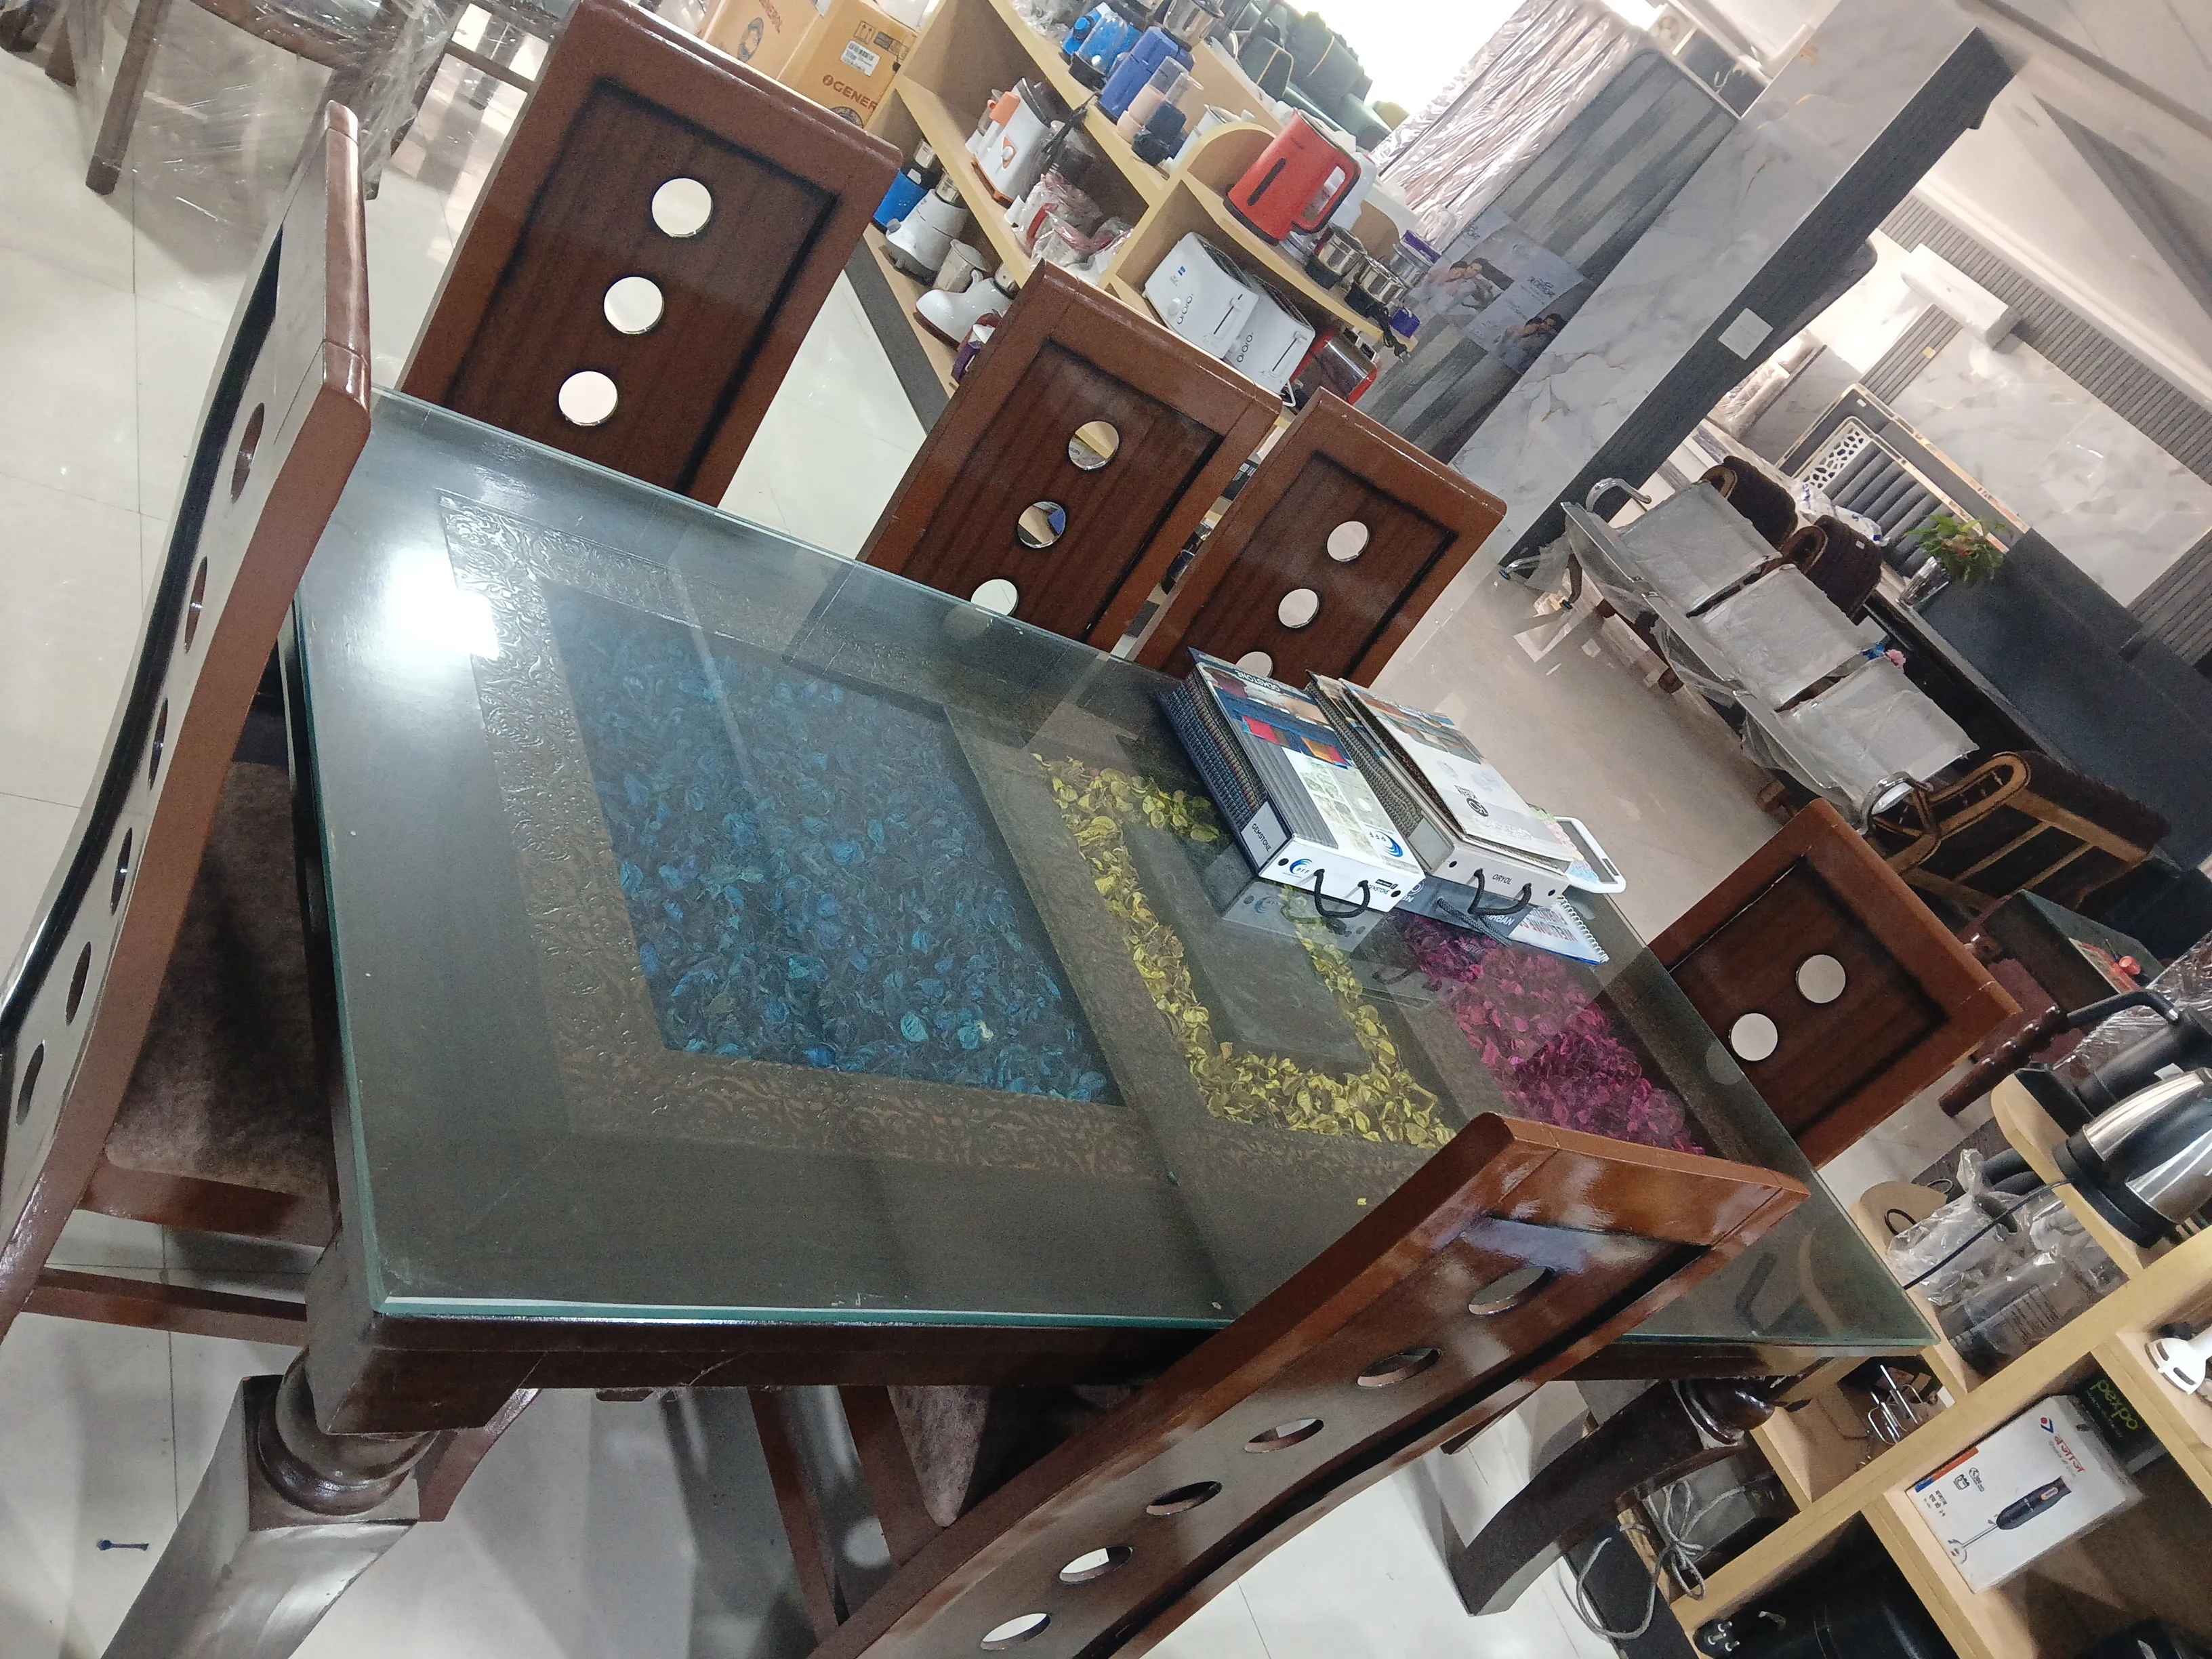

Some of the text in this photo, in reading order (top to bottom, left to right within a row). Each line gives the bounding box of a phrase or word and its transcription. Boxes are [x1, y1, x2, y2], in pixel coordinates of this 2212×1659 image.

[1234, 670, 1280, 691] GEMSTONE
[1252, 823, 1272, 853] GEMSTONE
[1369, 832, 1387, 842] PFF
[1492, 874, 1513, 885] ORYOL
[1401, 895, 1414, 903] BN
[2089, 1379, 2139, 1431] pexpo
[2054, 1433, 2086, 1473] बजाज
